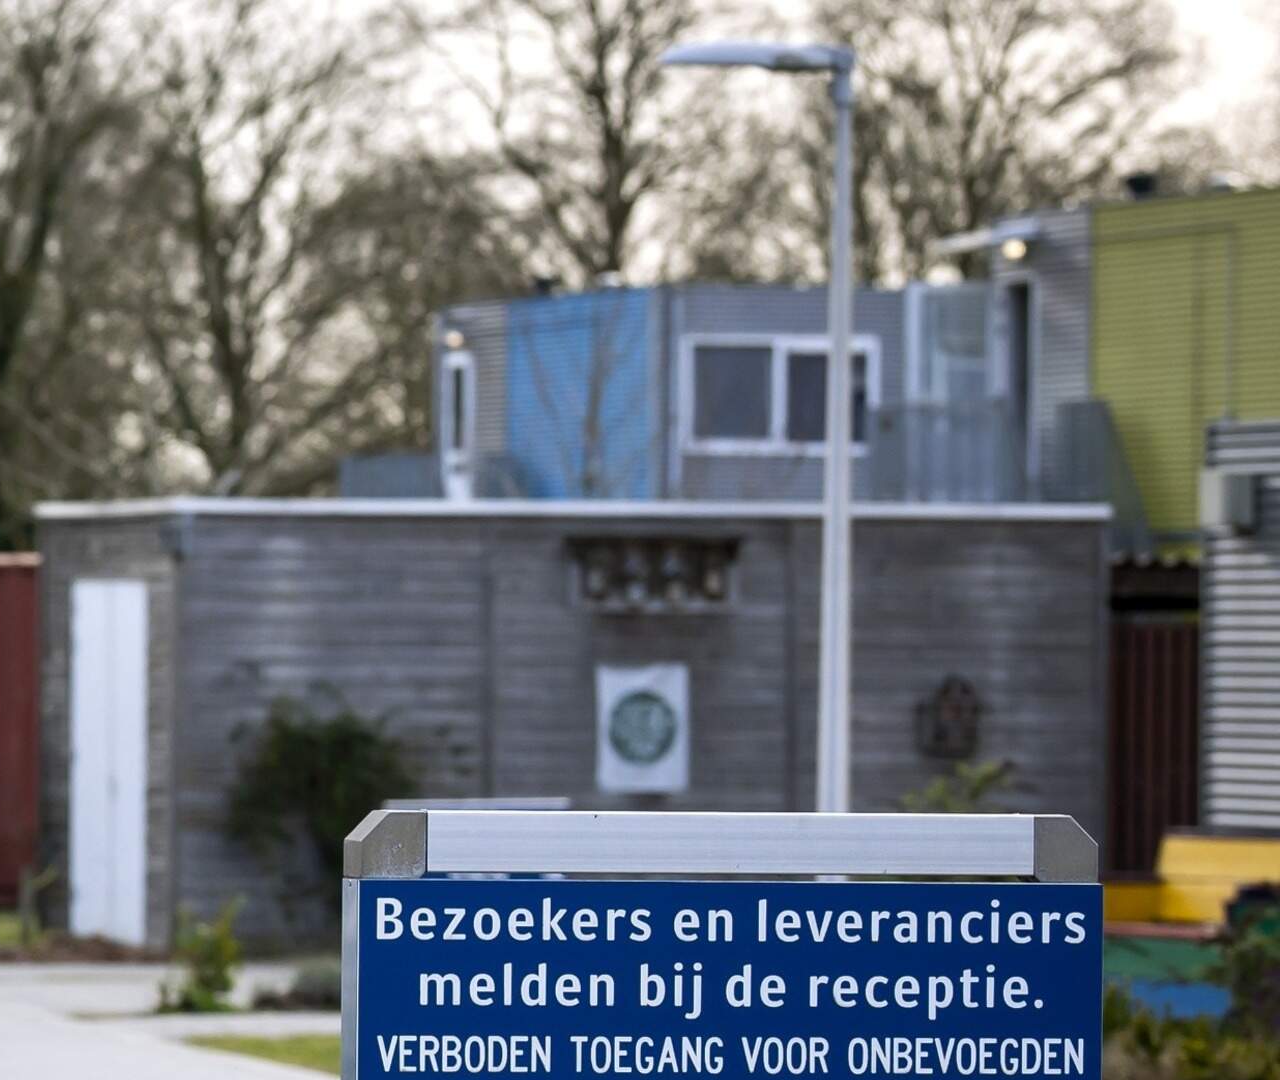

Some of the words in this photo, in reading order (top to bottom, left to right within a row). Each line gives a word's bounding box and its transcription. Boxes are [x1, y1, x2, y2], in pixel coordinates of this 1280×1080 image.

[376, 897, 652, 942] Bezoekers
[673, 909, 733, 942] en
[758, 898, 1086, 944] leveranciers
[419, 962, 615, 1007] melden
[640, 962, 703, 1020] bij
[725, 963, 786, 1008] de
[809, 964, 1044, 1021] receptie.
[376, 1035, 552, 1073] VERBODEN
[570, 1035, 724, 1074] TOEGANG
[741, 1036, 830, 1075] VOOR
[847, 1037, 1084, 1075] ONBEVOEGDEN
